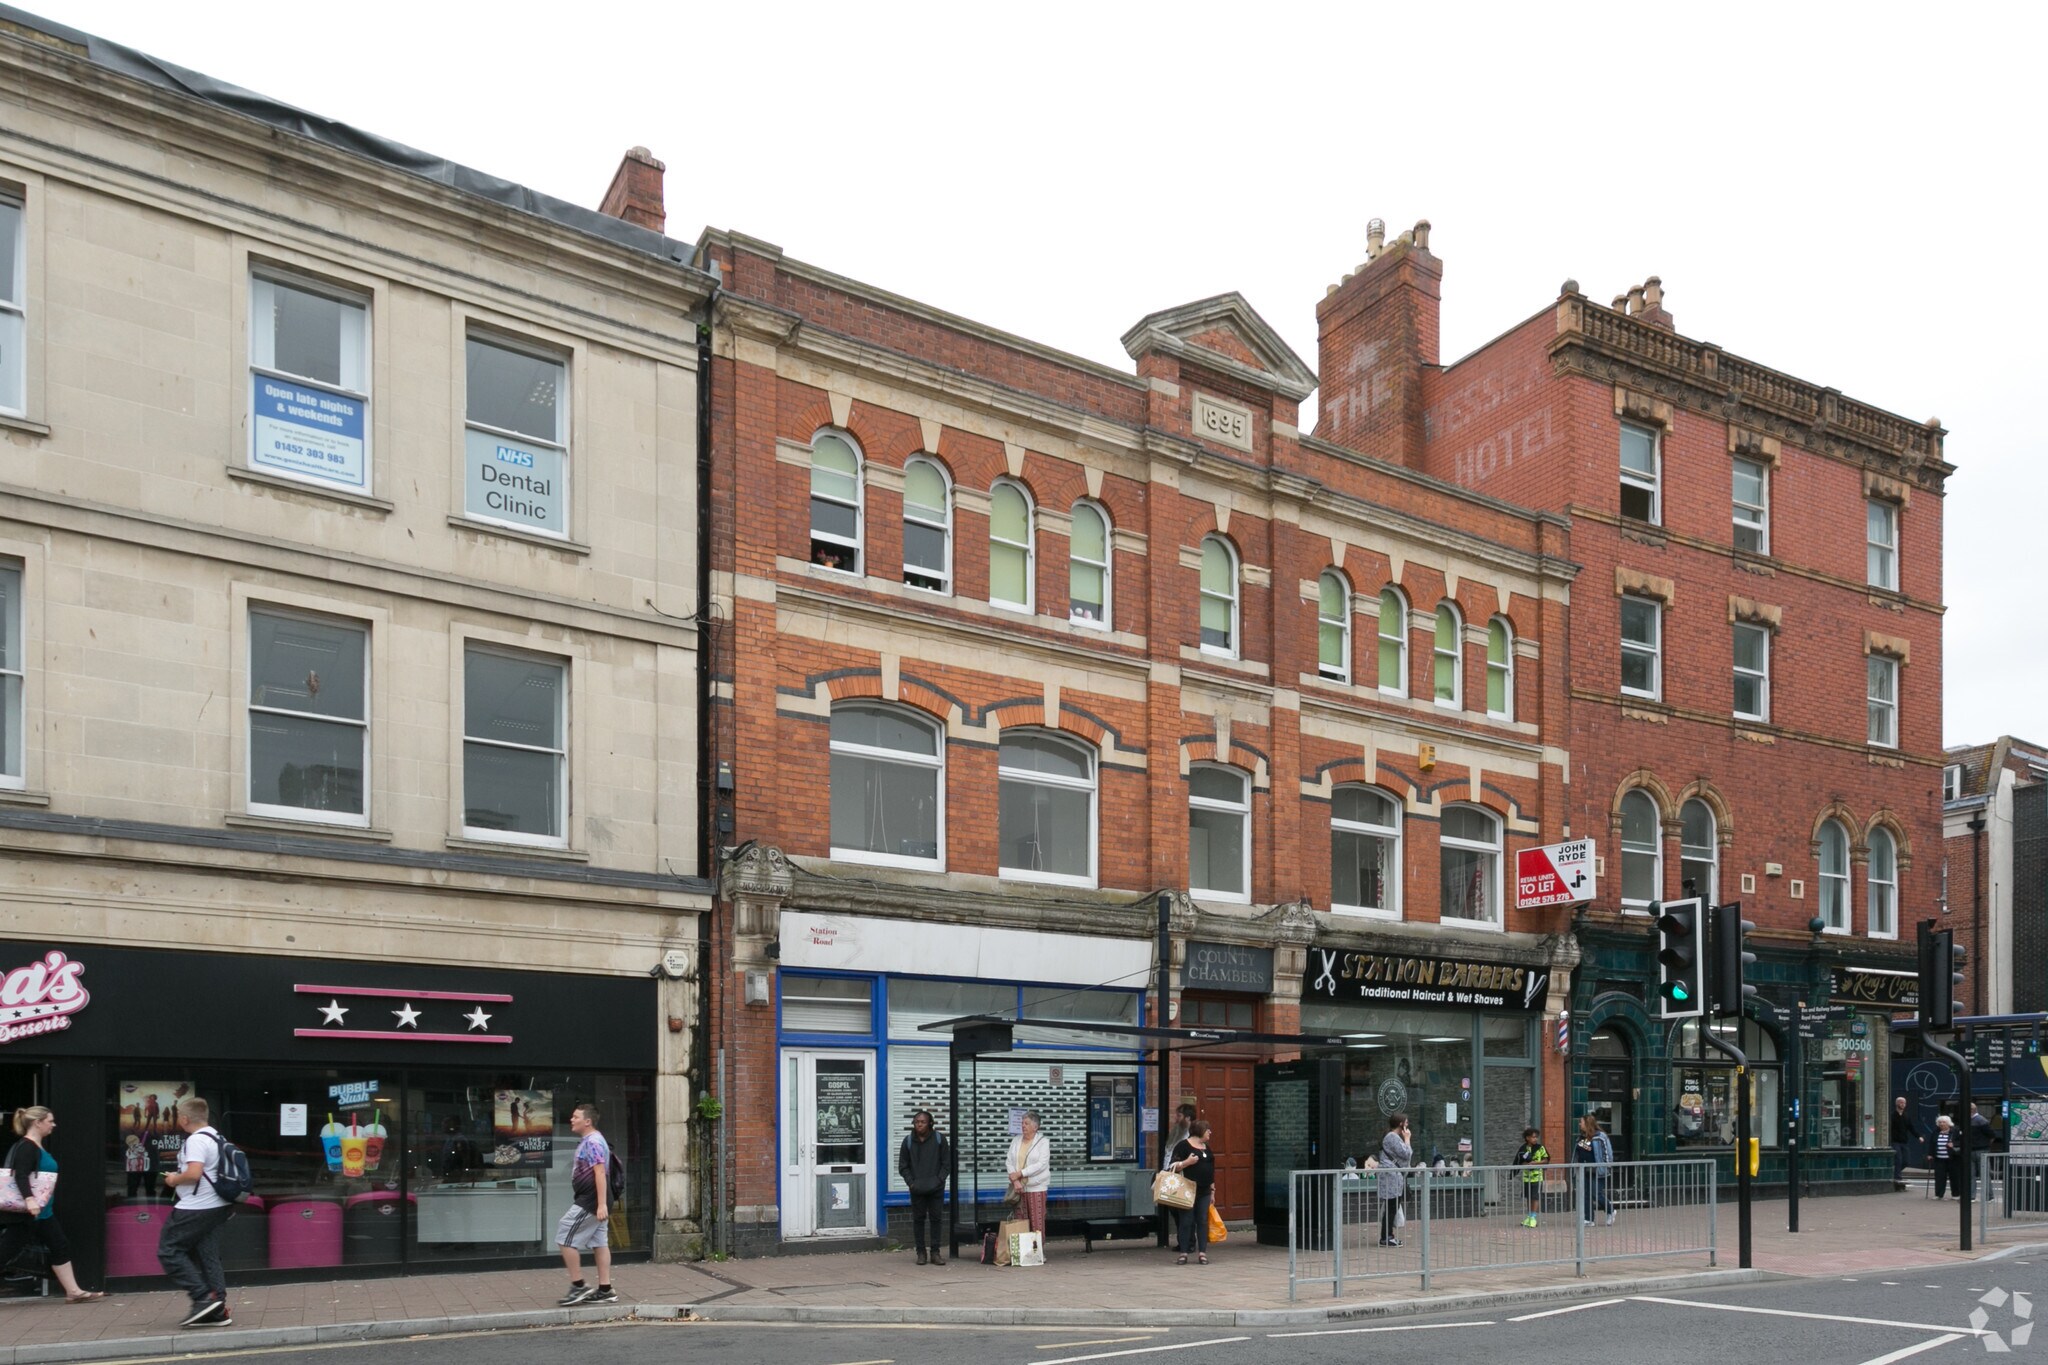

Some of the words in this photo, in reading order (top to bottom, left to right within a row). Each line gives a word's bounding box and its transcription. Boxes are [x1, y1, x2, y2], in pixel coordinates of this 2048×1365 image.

[265, 384, 293, 401] Open
[296, 392, 318, 407] late
[320, 399, 354, 417] nights
[1326, 368, 1392, 431] THE
[276, 402, 286, 413] &
[288, 405, 343, 427] weekends
[1201, 404, 1244, 439] 1895
[274, 440, 304, 455] 01452
[498, 447, 532, 466] NHS
[482, 464, 550, 496] Dental
[486, 491, 546, 519] Clinic
[1558, 843, 1586, 854] JOHN
[1558, 852, 1586, 862] RYDE
[1538, 873, 1555, 881] UNITS
[1520, 883, 1535, 895] TO
[1538, 880, 1555, 893] LET
[1520, 896, 1540, 906] 01242
[810, 927, 838, 935] Station
[813, 937, 833, 946] Road
[1198, 949, 1256, 966] COUNTY
[0, 952, 81, 1005] a's
[1189, 967, 1264, 984] CHAMBERS
[1341, 953, 1436, 985] STATION
[1438, 961, 1524, 991] BARBERS
[1361, 985, 1410, 999] Traditional
[1412, 989, 1446, 1002] Haircut
[1447, 991, 1455, 1001] &
[1456, 992, 1472, 1003] Wet
[1474, 993, 1504, 1005] Shaves
[1837, 1038, 1873, 1051] 500506
[329, 1080, 378, 1097] BUBBLE
[828, 1081, 850, 1089] GOSPEL
[338, 1091, 369, 1105] Slush
